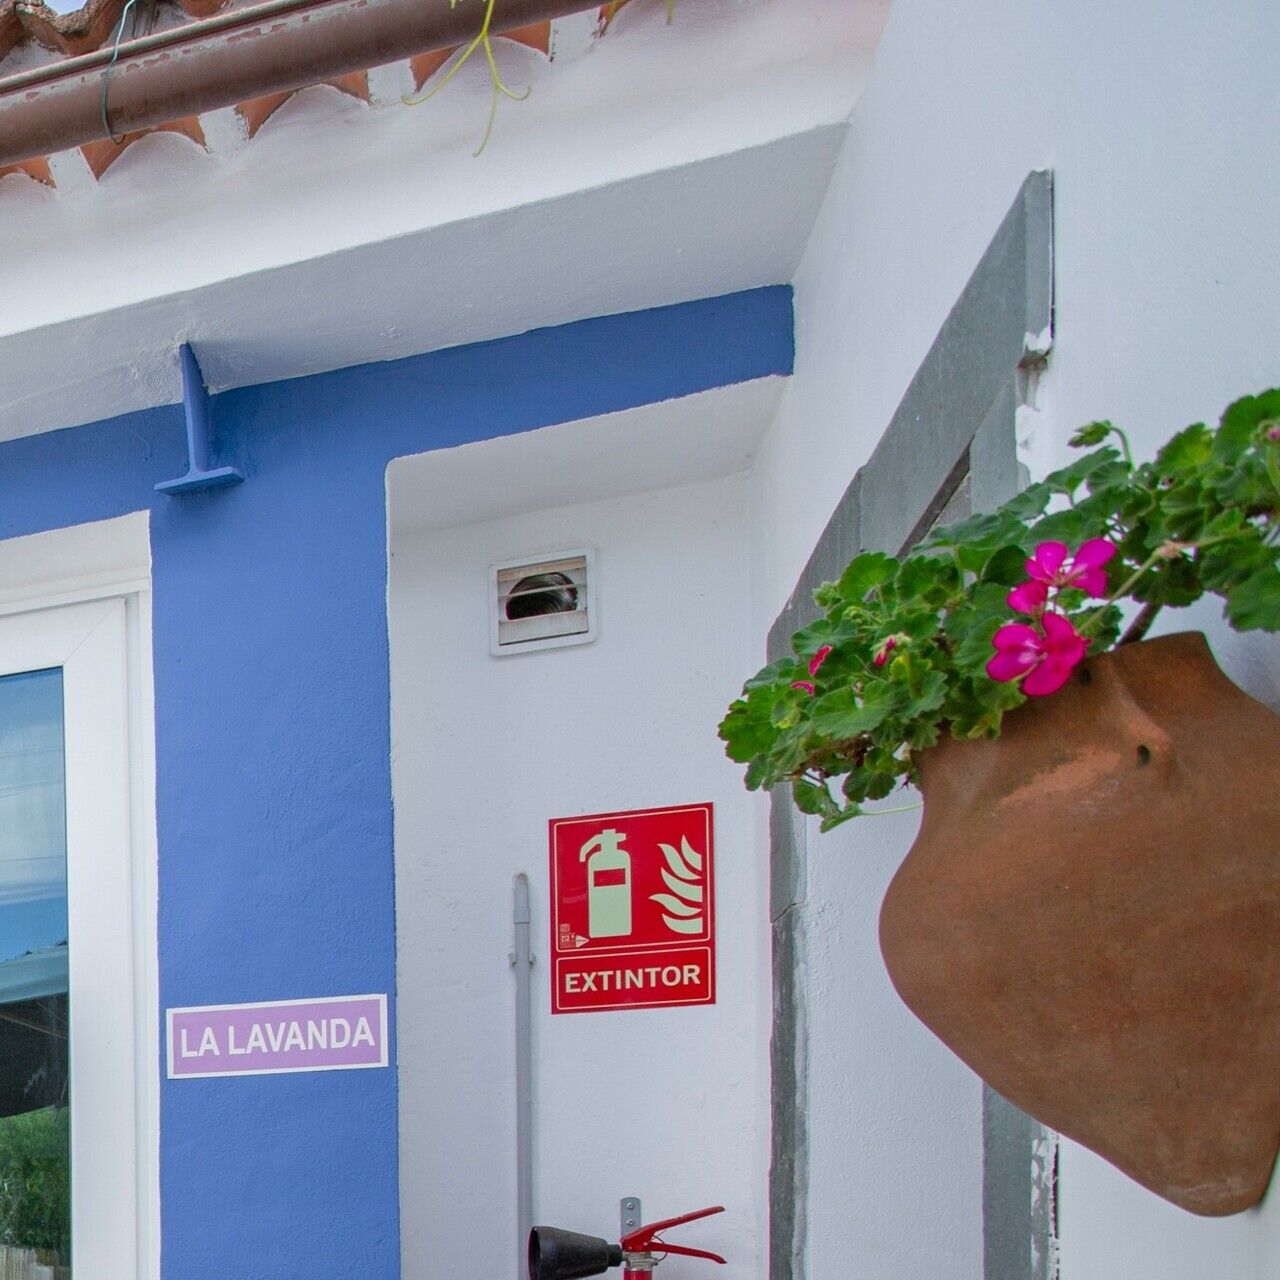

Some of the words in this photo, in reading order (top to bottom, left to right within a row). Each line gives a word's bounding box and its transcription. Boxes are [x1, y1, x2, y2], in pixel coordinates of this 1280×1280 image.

[565, 965, 701, 993] EXTINTOR
[181, 1027, 220, 1058] LA
[228, 1017, 376, 1055] LAVANDA
